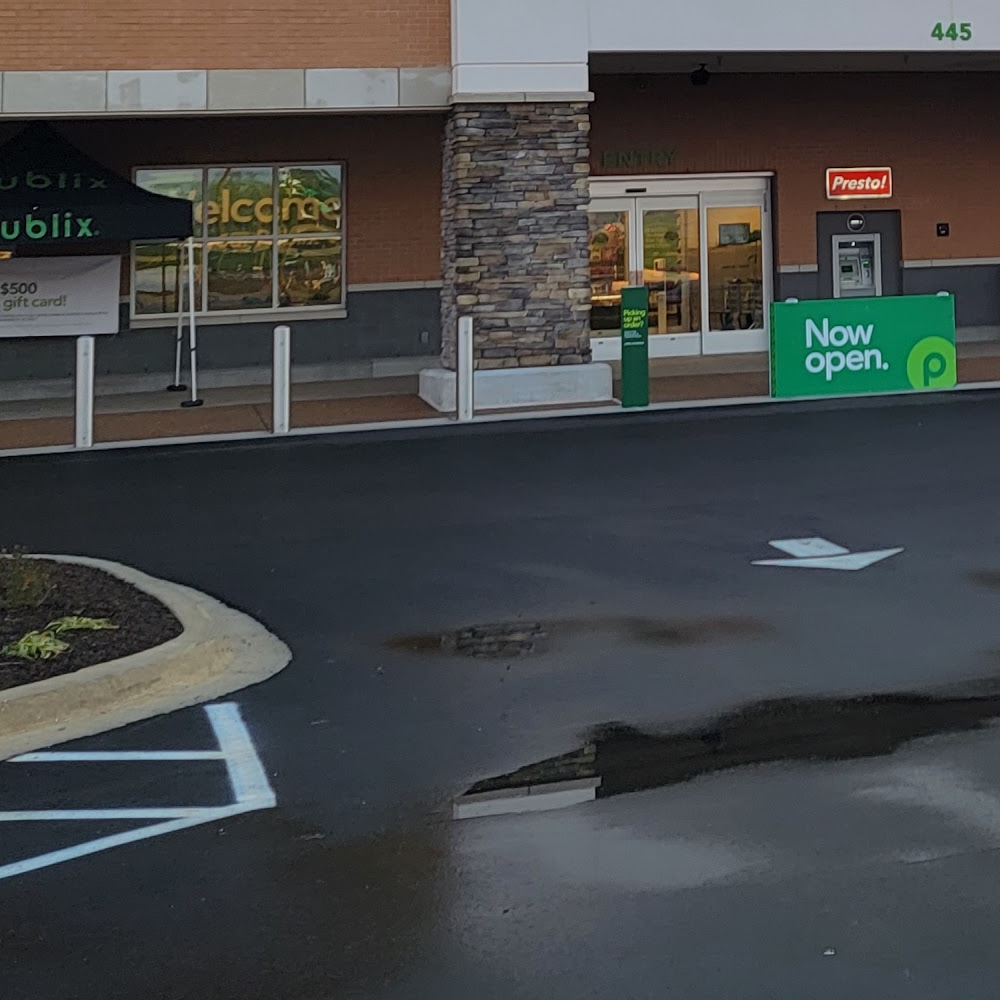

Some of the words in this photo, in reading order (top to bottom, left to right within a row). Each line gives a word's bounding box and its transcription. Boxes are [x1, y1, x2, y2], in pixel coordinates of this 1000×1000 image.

[931, 23, 972, 41] 445
[0, 171, 108, 190] ublix
[832, 175, 887, 191] Presto!
[188, 189, 342, 225] elcome
[0, 212, 94, 240] ublix
[0, 282, 38, 295] $500
[3, 296, 29, 311] gift
[31, 294, 67, 307] card!
[805, 318, 874, 349] Now
[805, 349, 889, 381] open.
